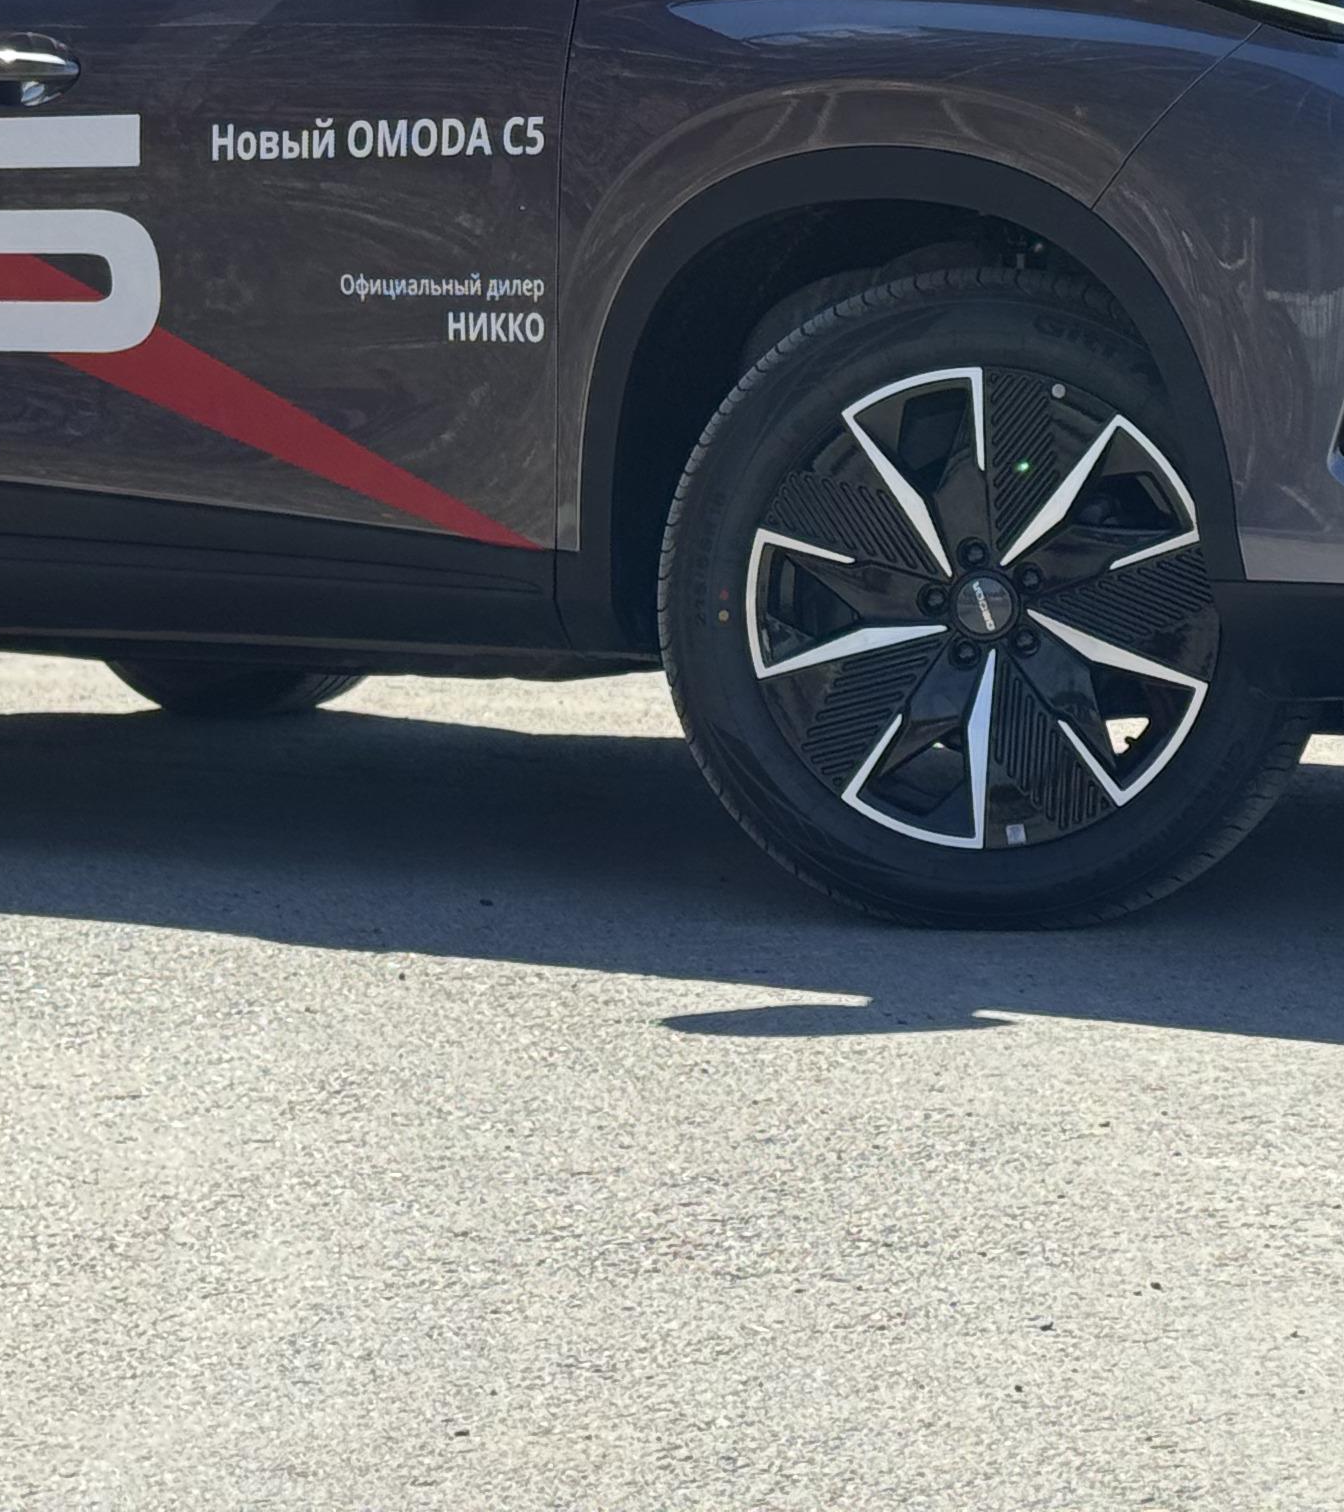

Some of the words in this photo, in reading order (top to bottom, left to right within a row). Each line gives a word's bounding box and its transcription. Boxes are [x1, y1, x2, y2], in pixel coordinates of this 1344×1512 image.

[211, 116, 336, 161] Новый
[346, 116, 493, 158] OMODA
[503, 115, 546, 156] C5
[339, 272, 482, 303] Официальный
[485, 278, 545, 303] дилер
[447, 311, 545, 344] НИККО
